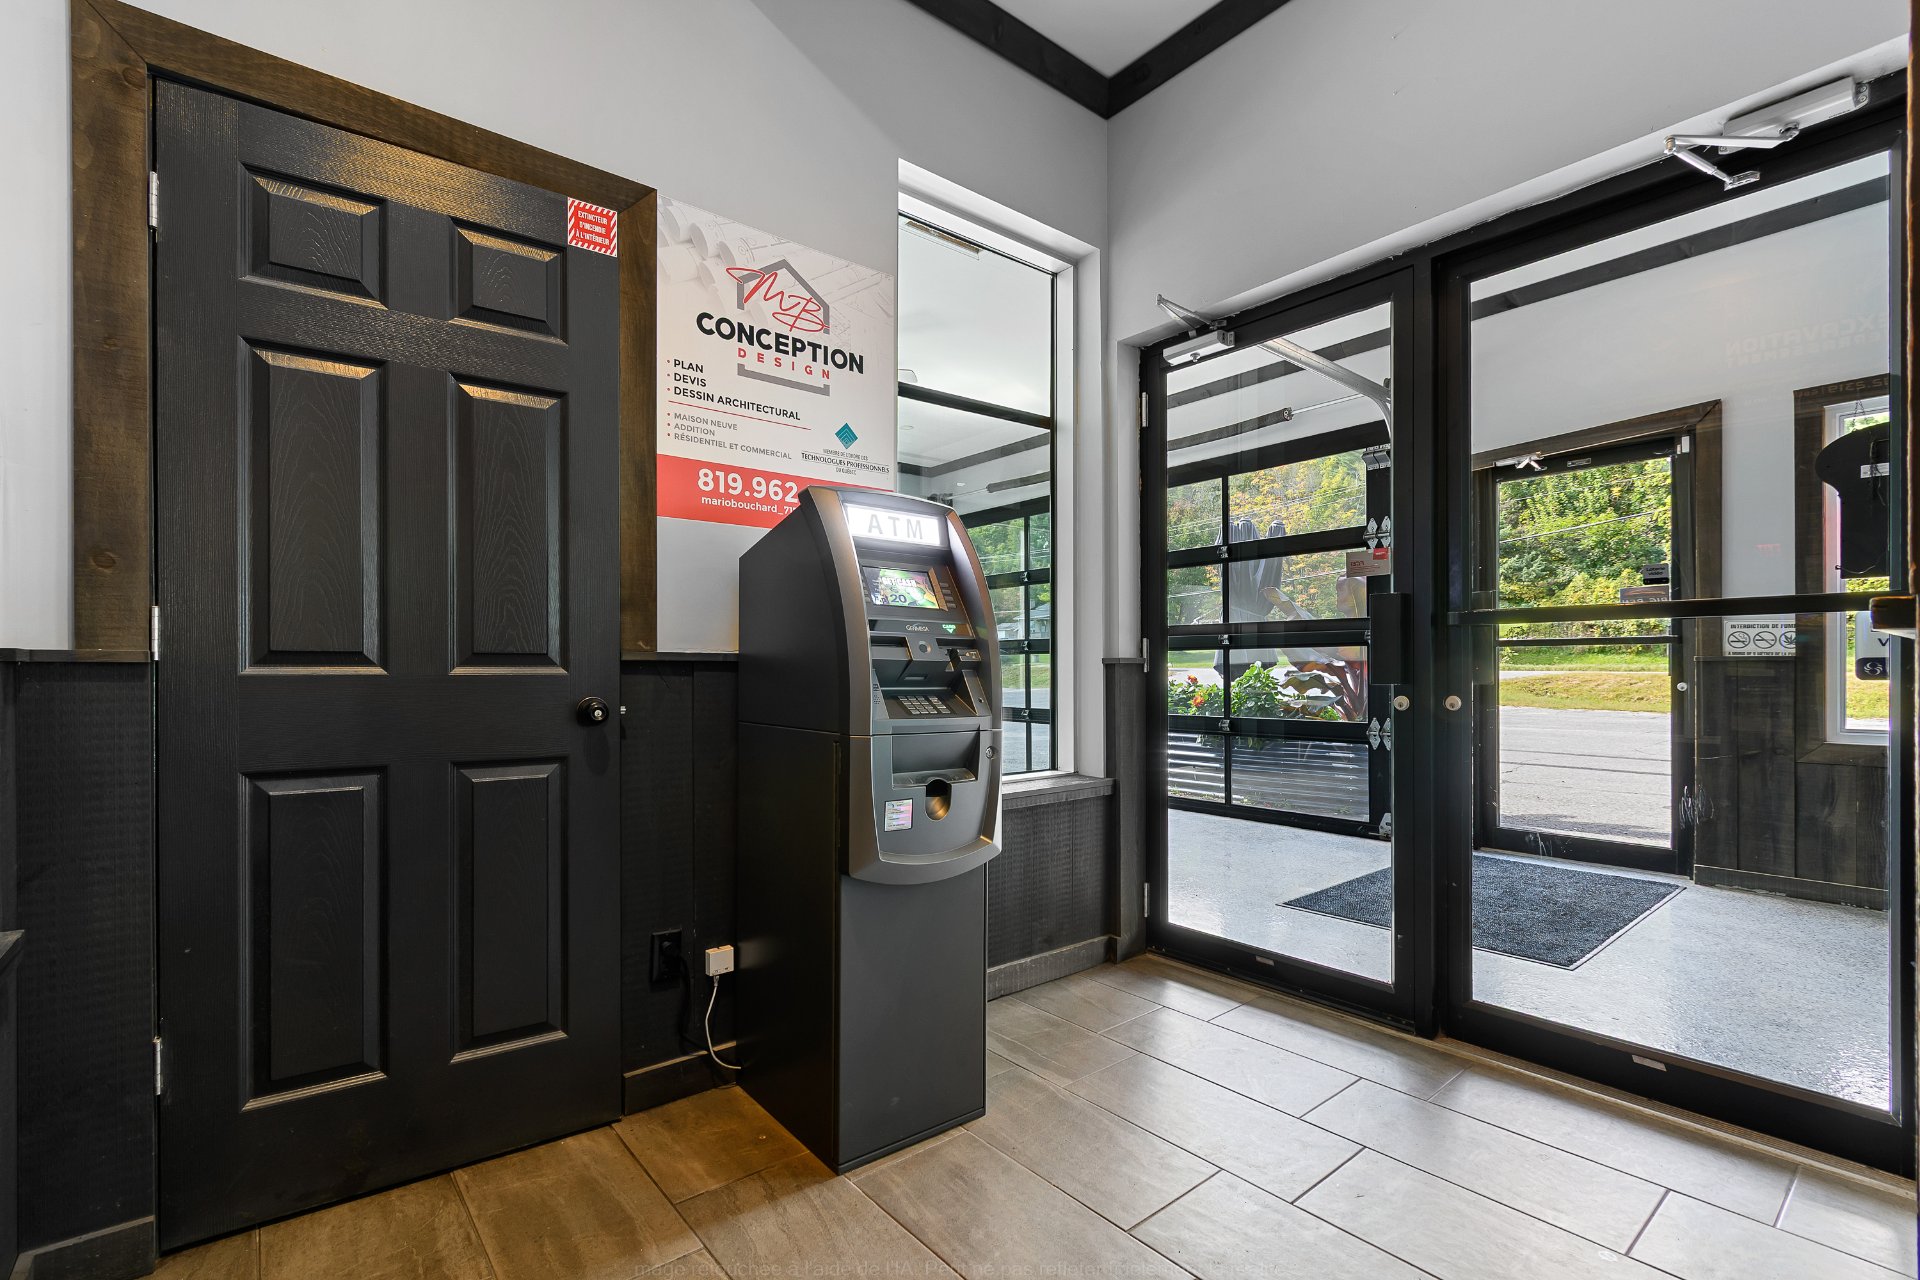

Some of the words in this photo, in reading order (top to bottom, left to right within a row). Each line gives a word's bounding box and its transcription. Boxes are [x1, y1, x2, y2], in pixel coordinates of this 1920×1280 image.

[577, 210, 608, 225] EXTINCTEUR
[579, 221, 607, 235] D'INCENDIE
[580, 231, 610, 246] L'INTÉRIEUR
[696, 311, 864, 375] CONCEPTION
[673, 358, 704, 374] PLAN
[737, 347, 830, 380] DESIGN
[673, 372, 707, 388] DEVIS
[673, 386, 715, 403] DESSIN
[717, 395, 801, 421] ARCHITECTURAL
[673, 423, 716, 437] ADDITION
[674, 412, 709, 425] MAISON
[710, 419, 738, 431] NEUVE
[674, 432, 728, 449] RÉSIDENTIEL
[729, 442, 739, 451] ET
[740, 444, 792, 460] COMMERCIAL
[801, 452, 846, 467] TECHNOLOGUES
[846, 460, 890, 474] PROFESSIONNELS
[697, 468, 799, 503] 819.962
[701, 496, 797, 515] mariobouchard_71
[867, 513, 924, 540] ATM
